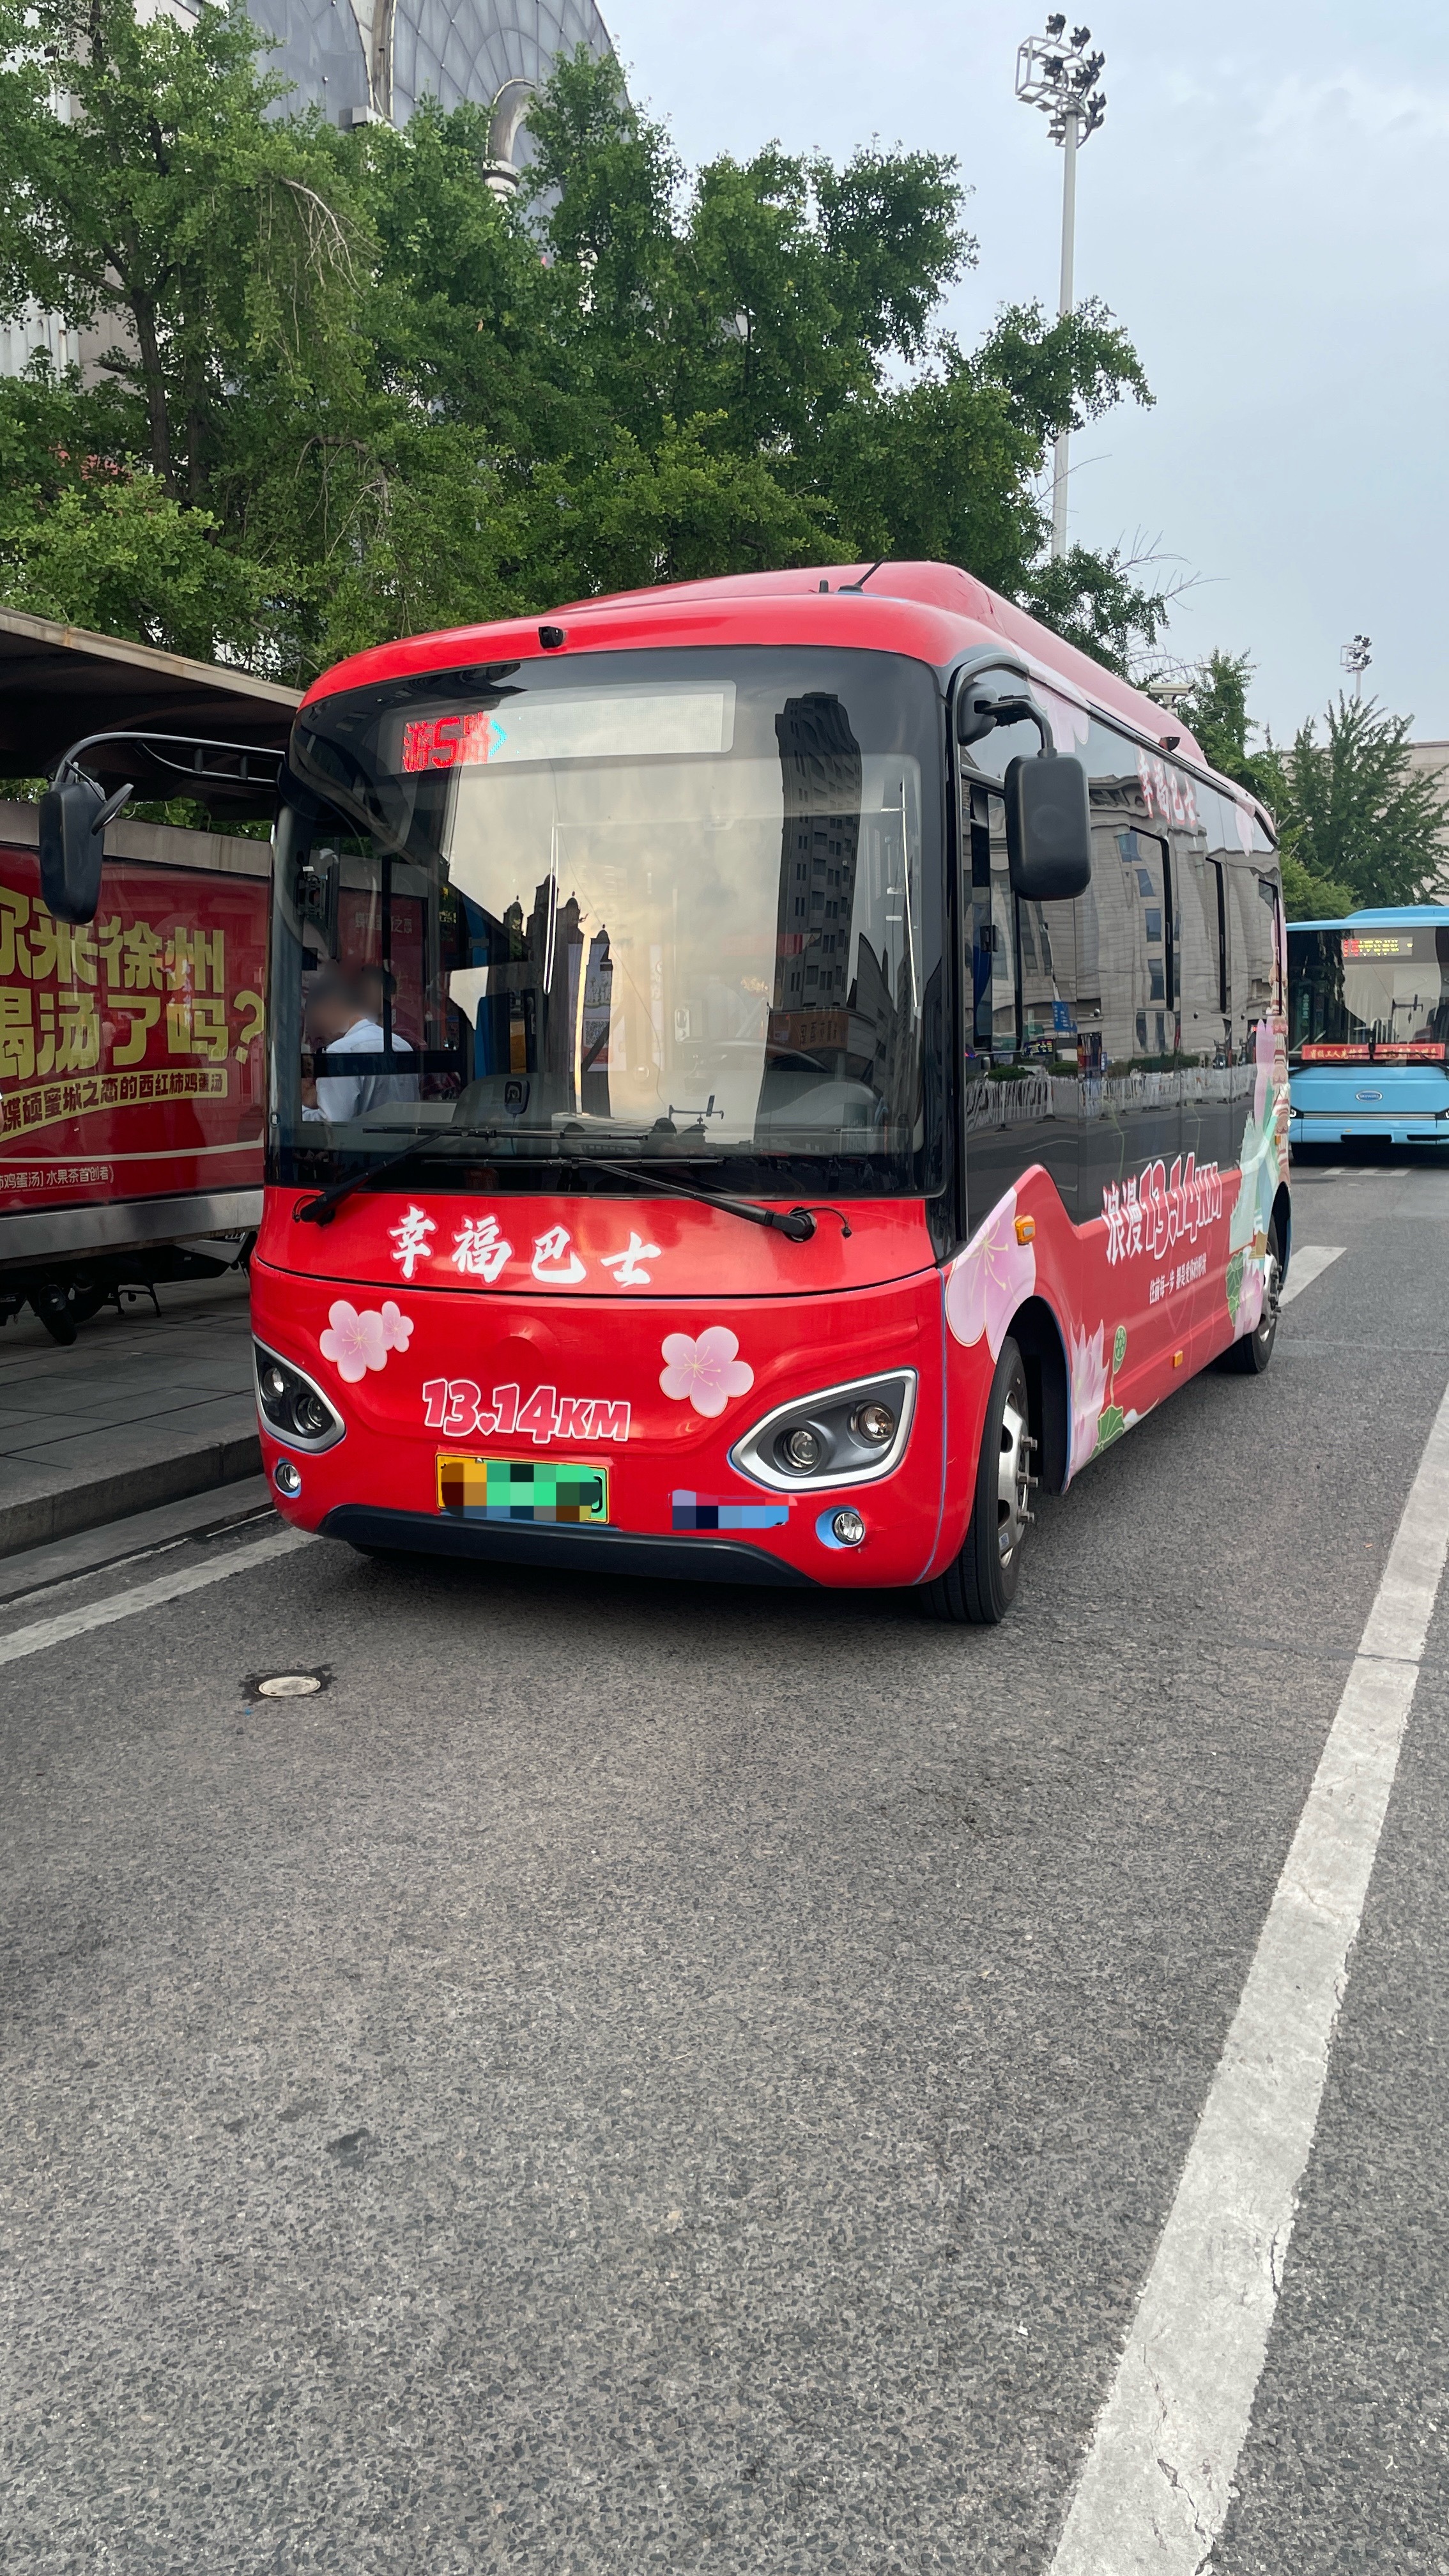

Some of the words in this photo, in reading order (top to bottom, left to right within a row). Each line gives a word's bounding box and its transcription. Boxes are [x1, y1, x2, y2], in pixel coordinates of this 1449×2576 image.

[402, 712, 490, 772] 游5路
[1138, 745, 1196, 827] 幸福巴士
[46, 1164, 114, 1186] 水果茶首创者)
[390, 1205, 662, 1289] 幸福巴士
